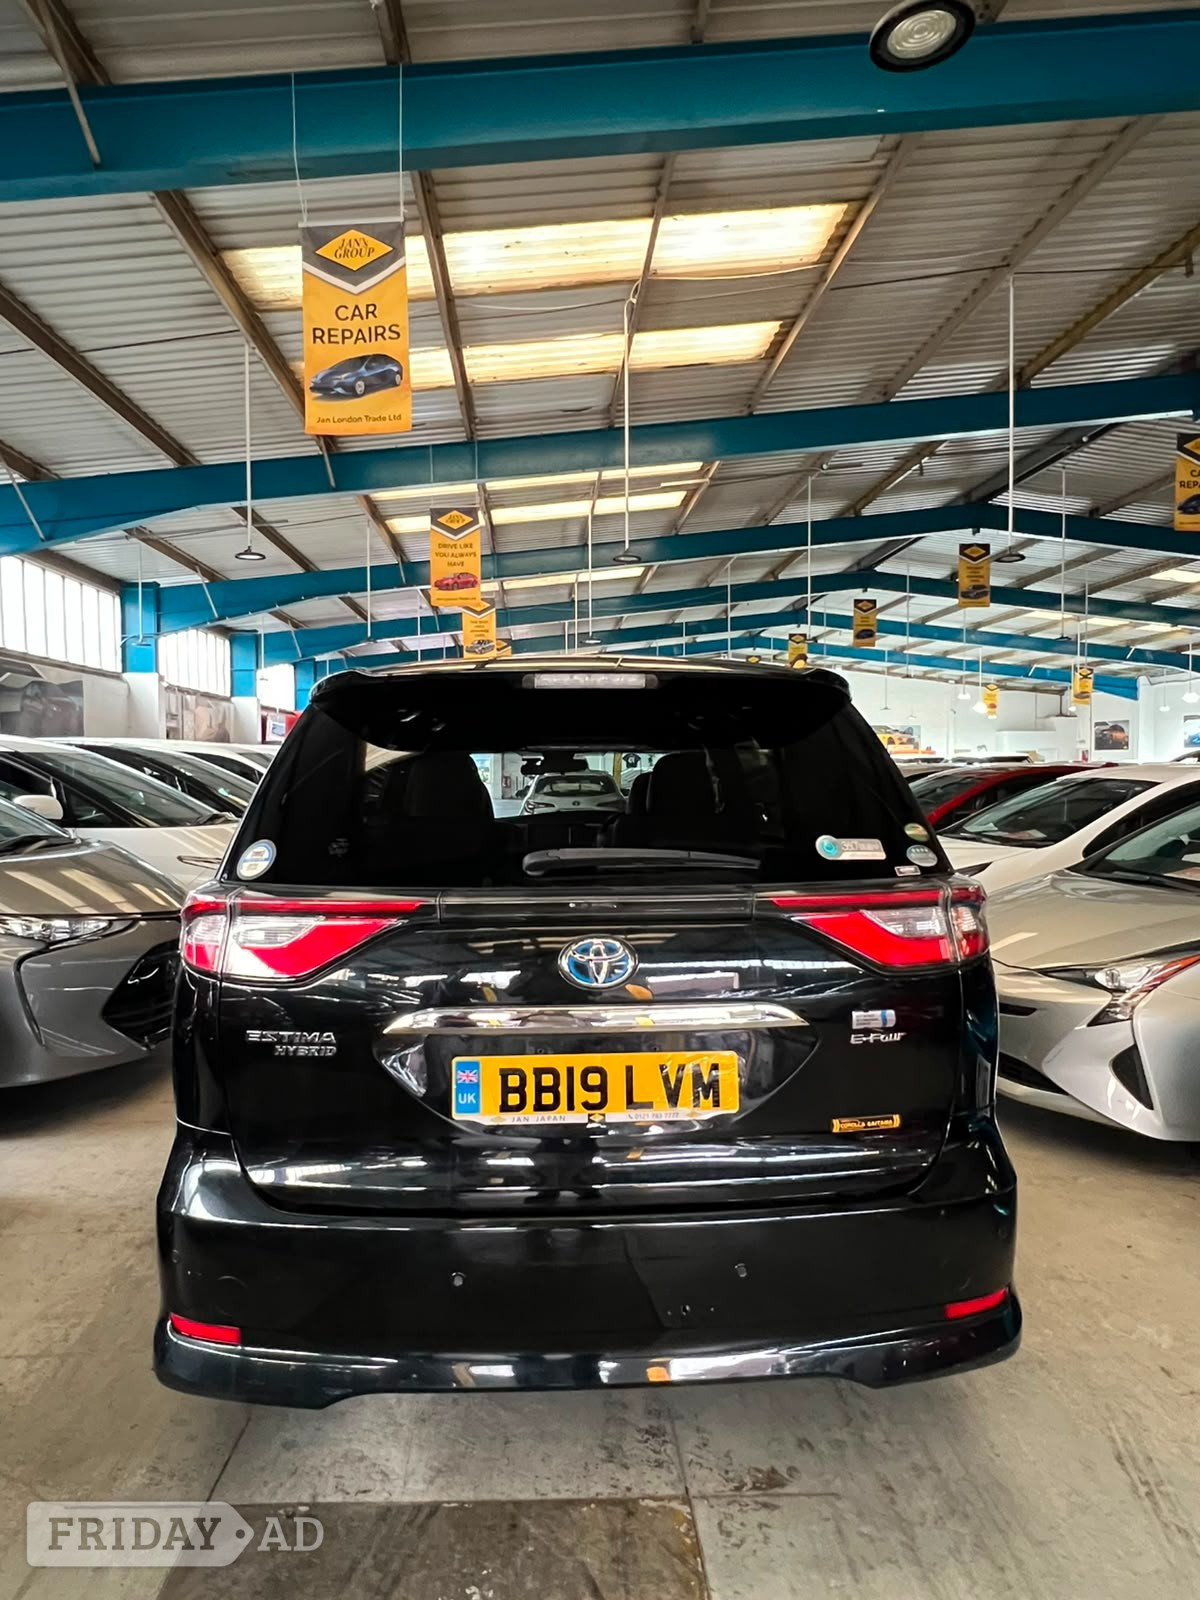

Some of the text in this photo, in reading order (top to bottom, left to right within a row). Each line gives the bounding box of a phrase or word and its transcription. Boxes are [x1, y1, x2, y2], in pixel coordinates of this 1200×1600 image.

[333, 246, 375, 260] GROUP
[335, 303, 377, 321] CAR
[312, 323, 401, 345] REPAIRS
[316, 413, 402, 424] Jan London Trade Ltd
[246, 1029, 337, 1044] ESTIMA
[273, 1044, 337, 1057] HYBRID
[499, 1066, 608, 1113] BB19
[458, 1093, 476, 1105] UK
[511, 1113, 566, 1123] JAN JAPAN
